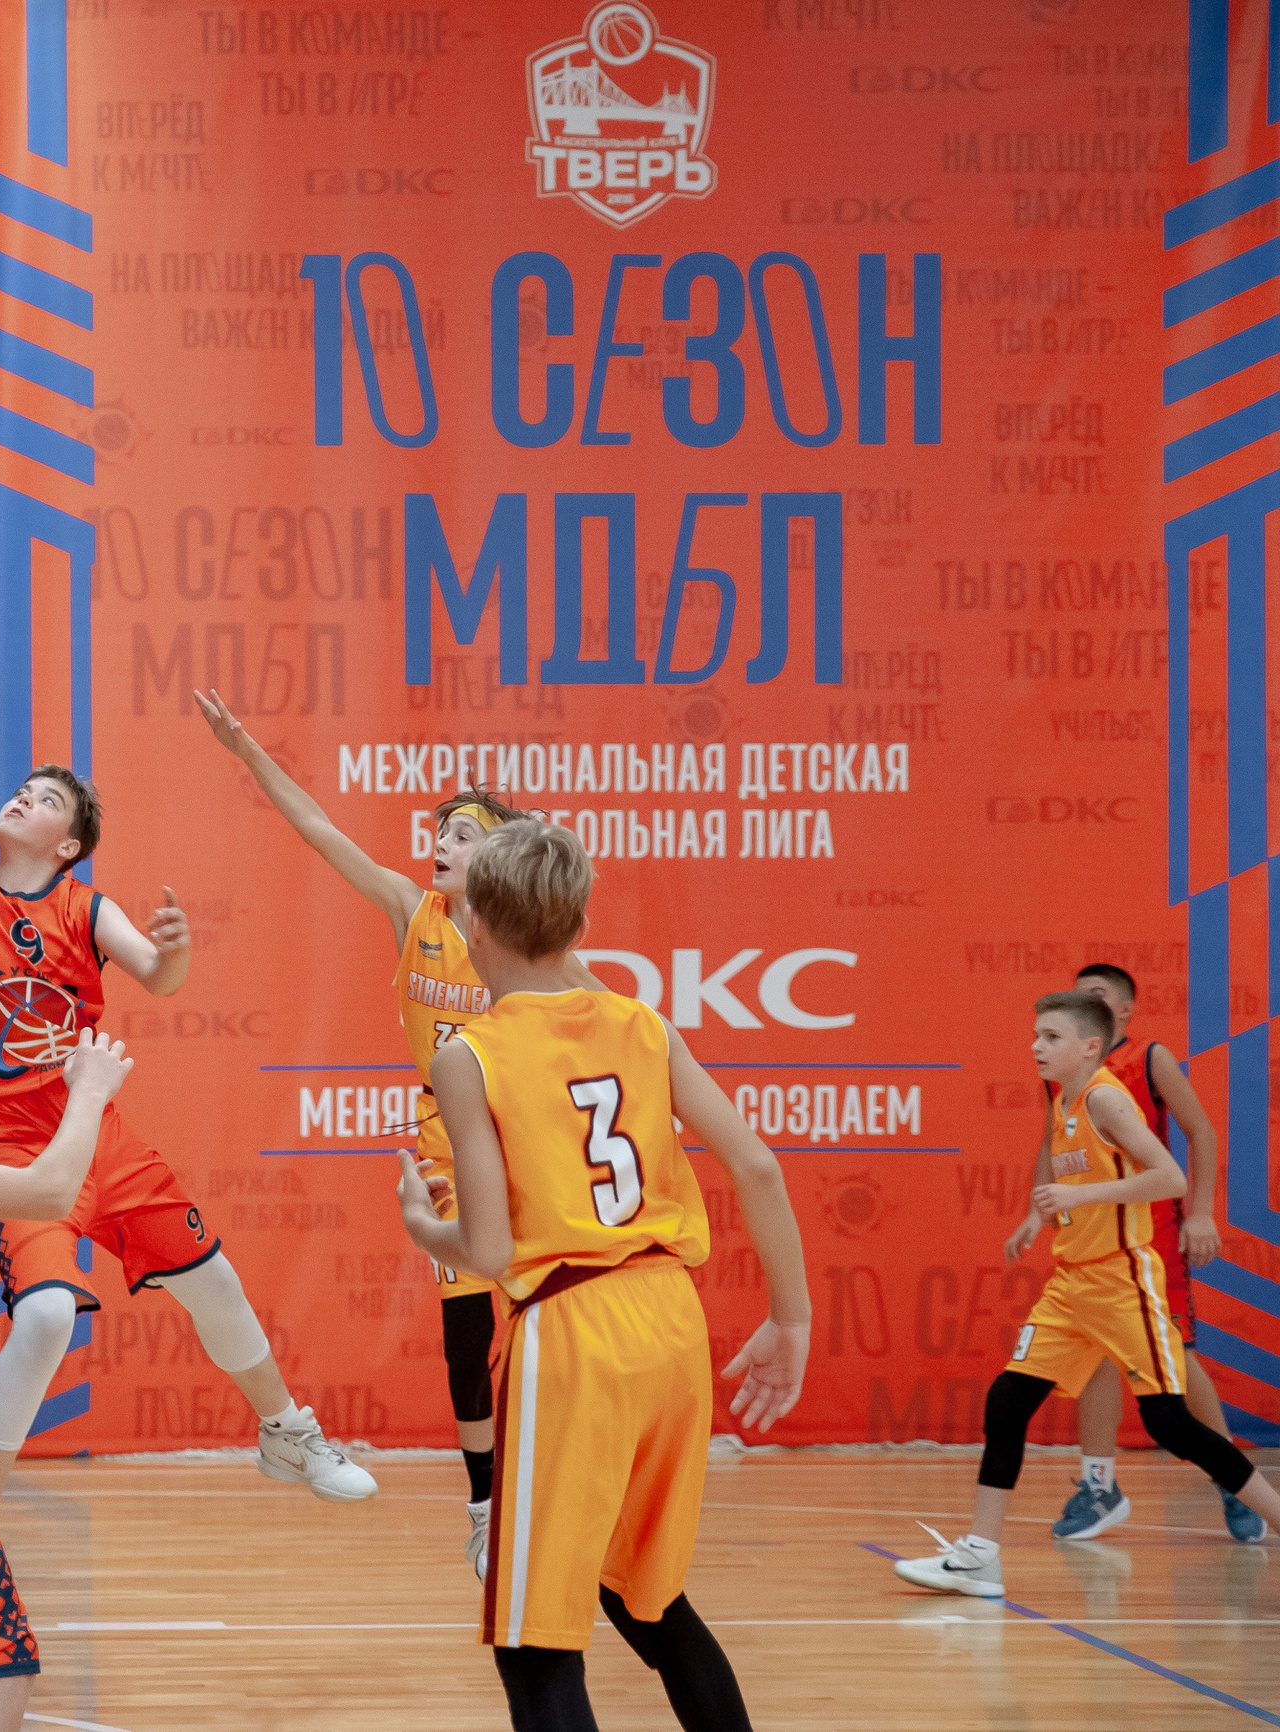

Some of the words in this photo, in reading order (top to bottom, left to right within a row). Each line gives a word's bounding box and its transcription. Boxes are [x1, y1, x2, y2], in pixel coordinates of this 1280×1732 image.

[198, 11, 248, 56] ТЫ
[259, 11, 279, 56] В
[288, 9, 450, 61] КОМАНДЕ
[257, 71, 307, 116] ТЫ
[317, 71, 338, 116] В
[346, 70, 428, 117] ИГРЕ
[901, 65, 1004, 94] DKC
[96, 93, 206, 145] ВПЕРЁД
[91, 153, 112, 193] К
[120, 152, 214, 194] МЕЧТЕ
[531, 145, 711, 192] ТВЕРЬ
[941, 131, 983, 174] НА
[355, 167, 456, 196] DKC
[832, 198, 935, 226] DKC
[110, 252, 151, 295] НА
[181, 307, 289, 351] ВАЖЕН
[299, 251, 439, 448] 10
[491, 251, 942, 448] СЕЗОН
[227, 426, 297, 447] DKC
[994, 395, 1105, 448] ВПЕРЁД
[990, 456, 1010, 495] К
[174, 504, 394, 602] СЕЗОН
[405, 491, 843, 684] МДБЛ
[933, 560, 991, 612] ТЫ
[1004, 560, 1028, 612] В
[131, 622, 347, 718] МДБЛ
[1001, 629, 1060, 681] ТЫ
[1071, 629, 1095, 681] В
[1105, 629, 1197, 681] ИГР
[338, 743, 727, 793] МЕЖРЕГИОНАЛЬНАЯ
[739, 743, 910, 799] ДЕТСКАЯ
[739, 809, 835, 858] ЛИГА
[1038, 796, 1140, 824] DKC
[10, 916, 46, 965] 9
[173, 1010, 271, 1038] DKC
[299, 1085, 425, 1138] МЕНЯЕ
[734, 1084, 922, 1144] СОЗДАЕМ
[568, 1073, 645, 1228] 3
[185, 1206, 207, 1243] 9
[824, 1265, 891, 1358] 10
[915, 1265, 1052, 1358] СЕЗ
